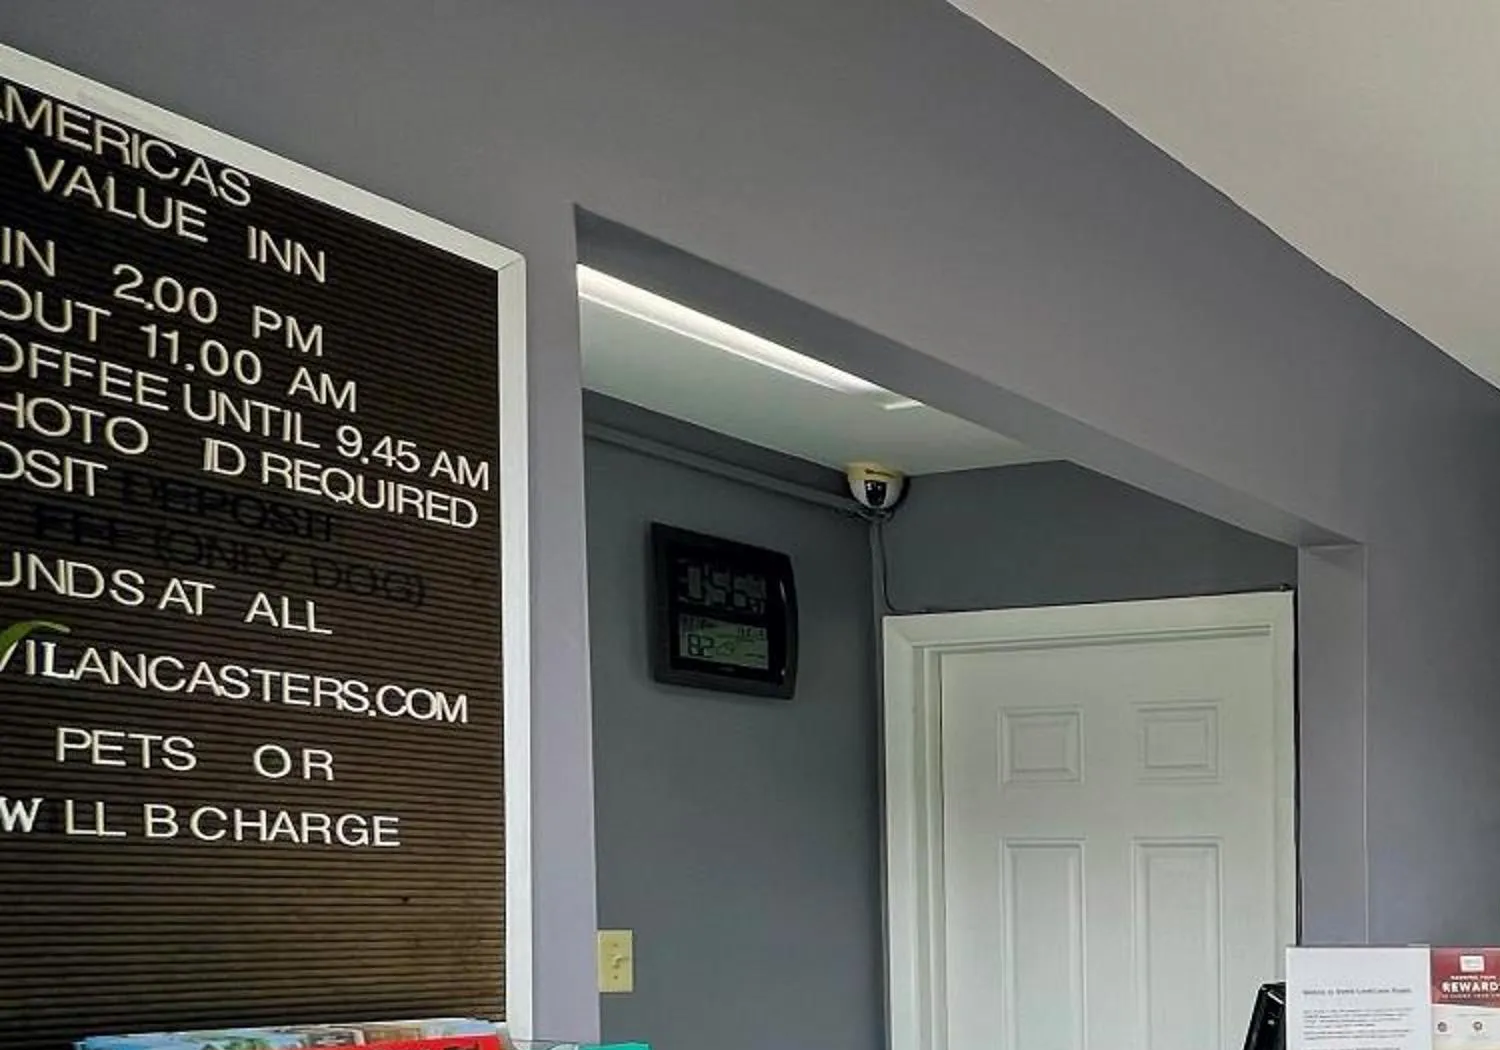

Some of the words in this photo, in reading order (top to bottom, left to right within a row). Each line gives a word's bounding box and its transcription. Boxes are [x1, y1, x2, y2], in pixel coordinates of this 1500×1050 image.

[0, 84, 251, 206] MERICAS
[25, 146, 209, 243] VALUE
[246, 225, 327, 283] INN
[2, 225, 56, 277] IN
[112, 263, 218, 324] 2.00
[251, 305, 324, 357] PM
[140, 323, 262, 385] 11.00
[288, 367, 357, 413] AM
[183, 383, 320, 449] UNTIL
[336, 425, 421, 473] 9.45
[430, 450, 490, 491] AM
[203, 437, 246, 476] ID
[261, 450, 479, 529] REQUIRED
[158, 577, 215, 616] AT
[244, 592, 333, 635] ALL
[56, 727, 197, 771] PETS
[252, 744, 334, 781] OR
[189, 806, 400, 847] CHARGE
